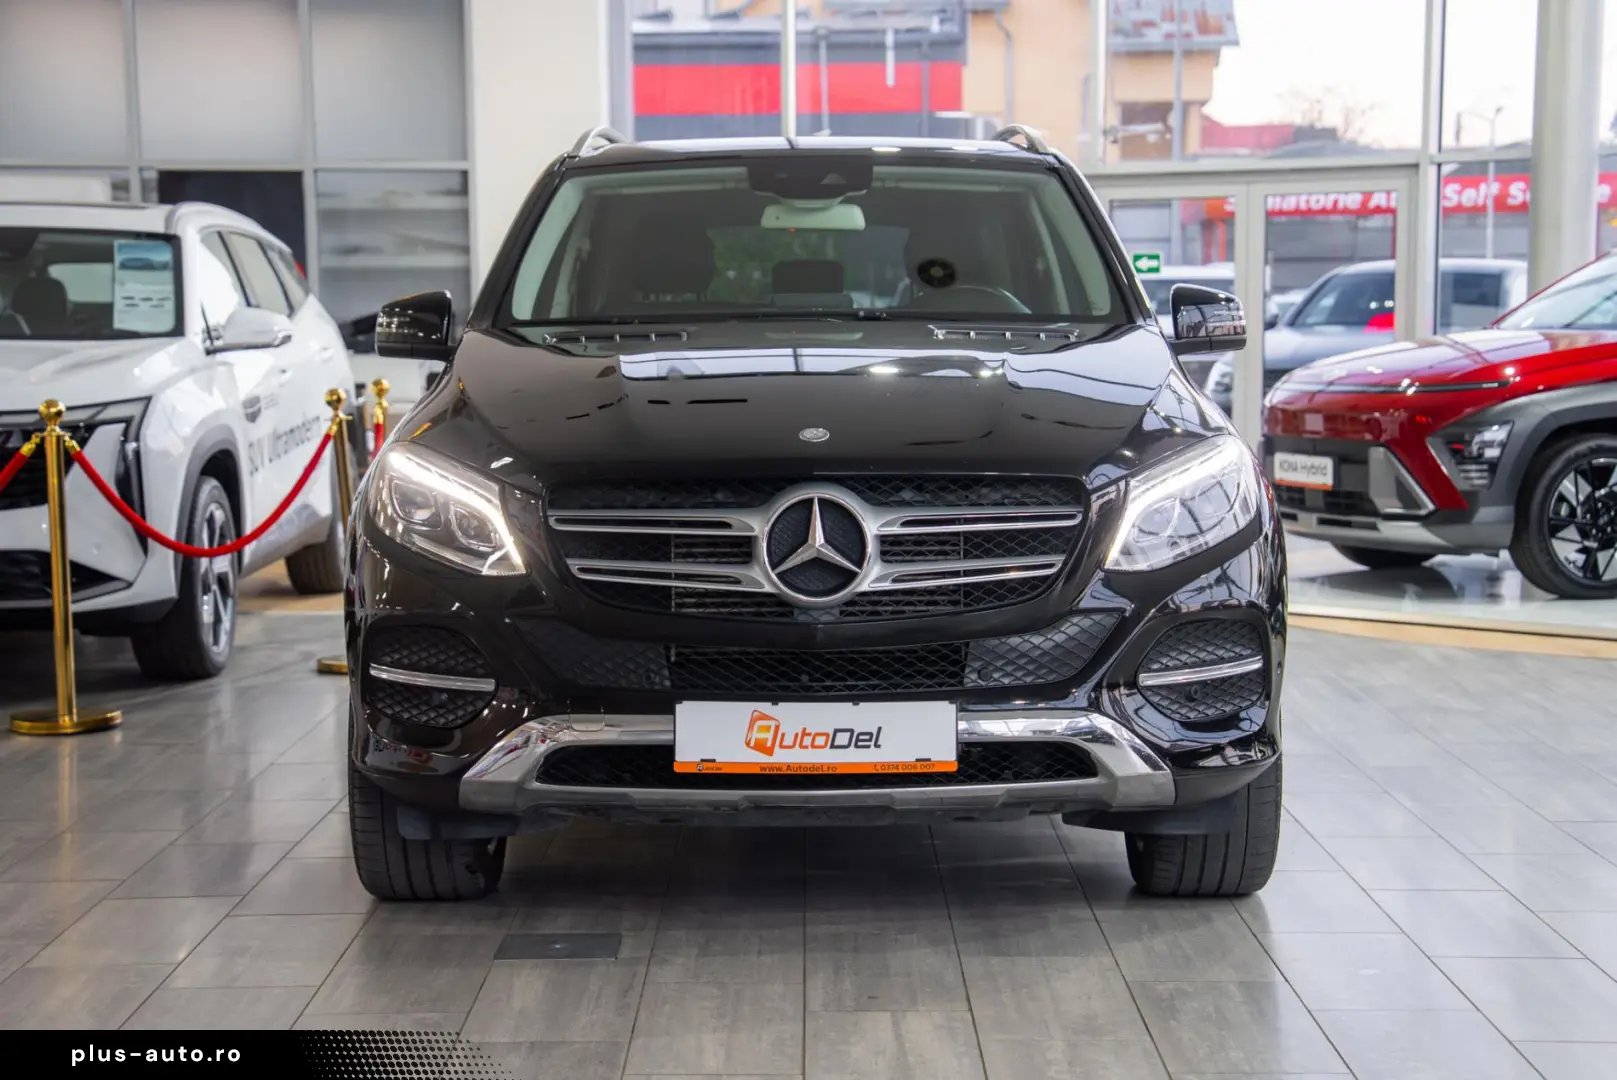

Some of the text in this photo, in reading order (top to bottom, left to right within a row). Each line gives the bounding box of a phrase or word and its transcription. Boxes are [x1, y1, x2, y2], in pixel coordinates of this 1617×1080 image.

[1443, 180, 1502, 208] Self
[1300, 460, 1328, 478] Hybrid
[745, 710, 882, 756] AutoDel
[759, 764, 837, 774] www.Autodel.ro
